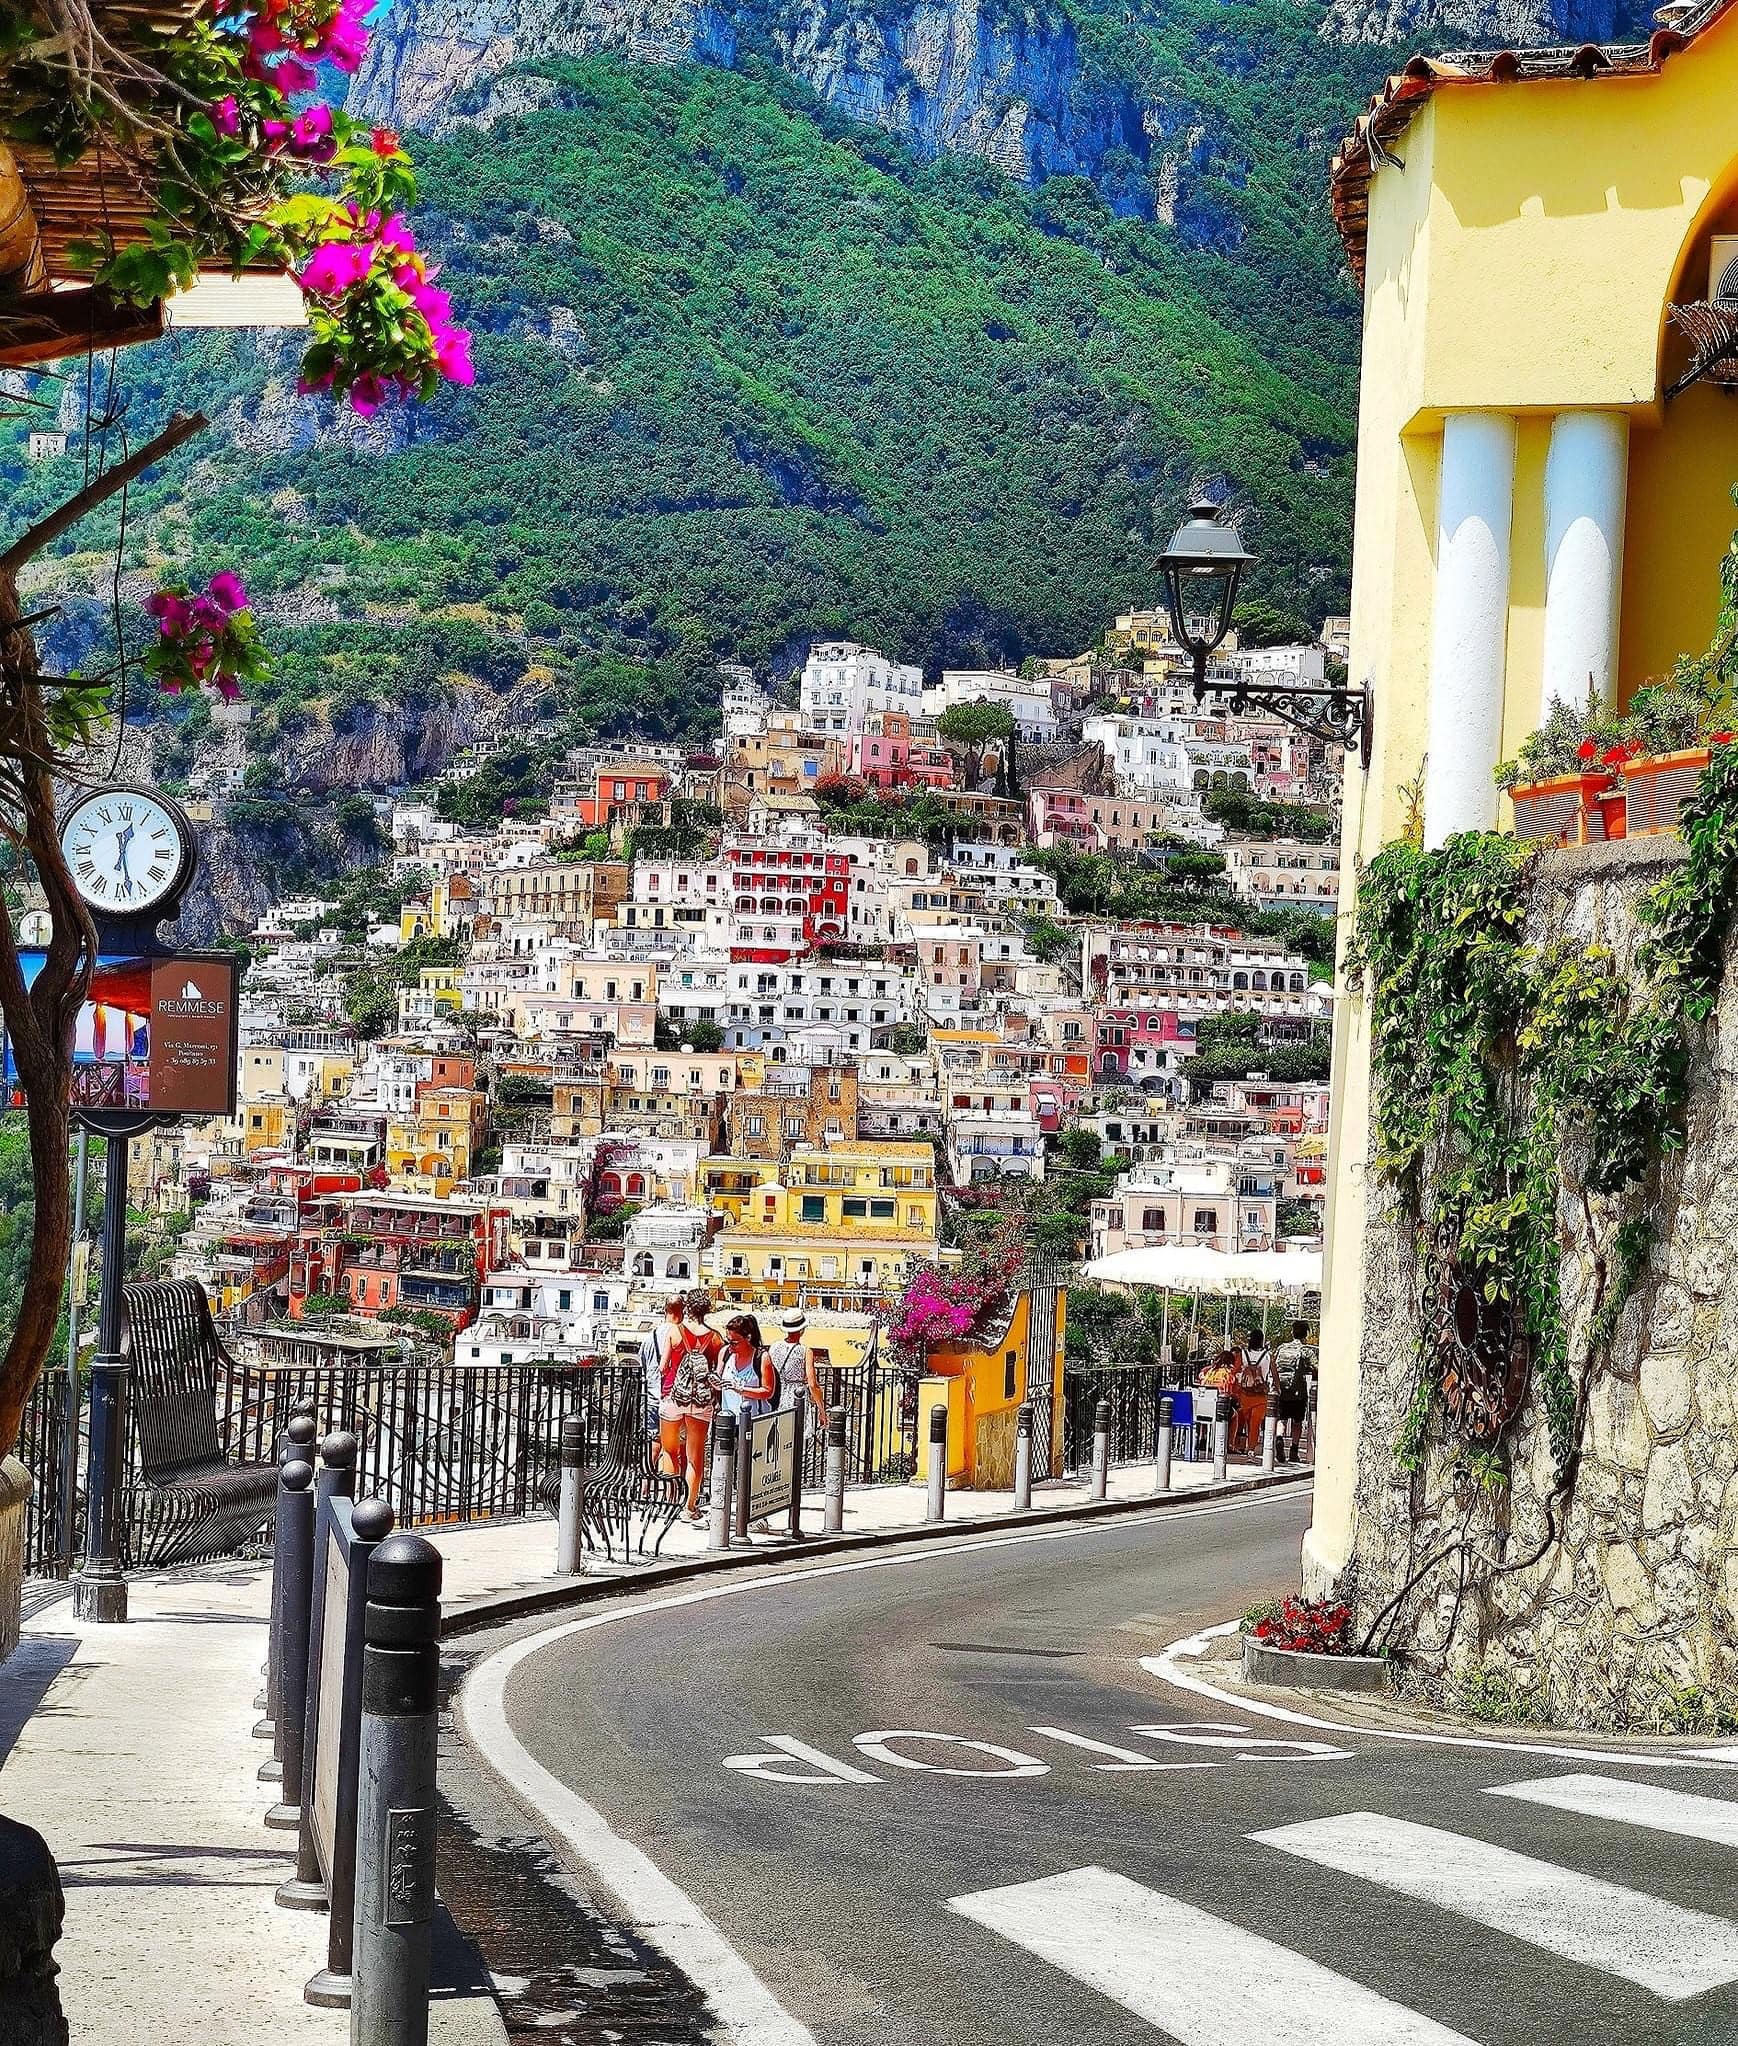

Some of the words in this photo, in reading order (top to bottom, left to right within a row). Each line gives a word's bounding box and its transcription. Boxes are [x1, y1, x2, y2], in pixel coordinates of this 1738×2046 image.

[97, 809, 113, 827] XI
[117, 806, 133, 821] XII
[139, 812, 151, 826] I
[81, 824, 98, 838] X
[150, 828, 166, 840] II
[75, 843, 92, 856] IX
[154, 849, 170, 860] III
[91, 875, 108, 894] VII
[136, 880, 148, 895] V
[158, 1000, 225, 1014] REMMESE
[721, 1722, 1358, 1785] STOP
